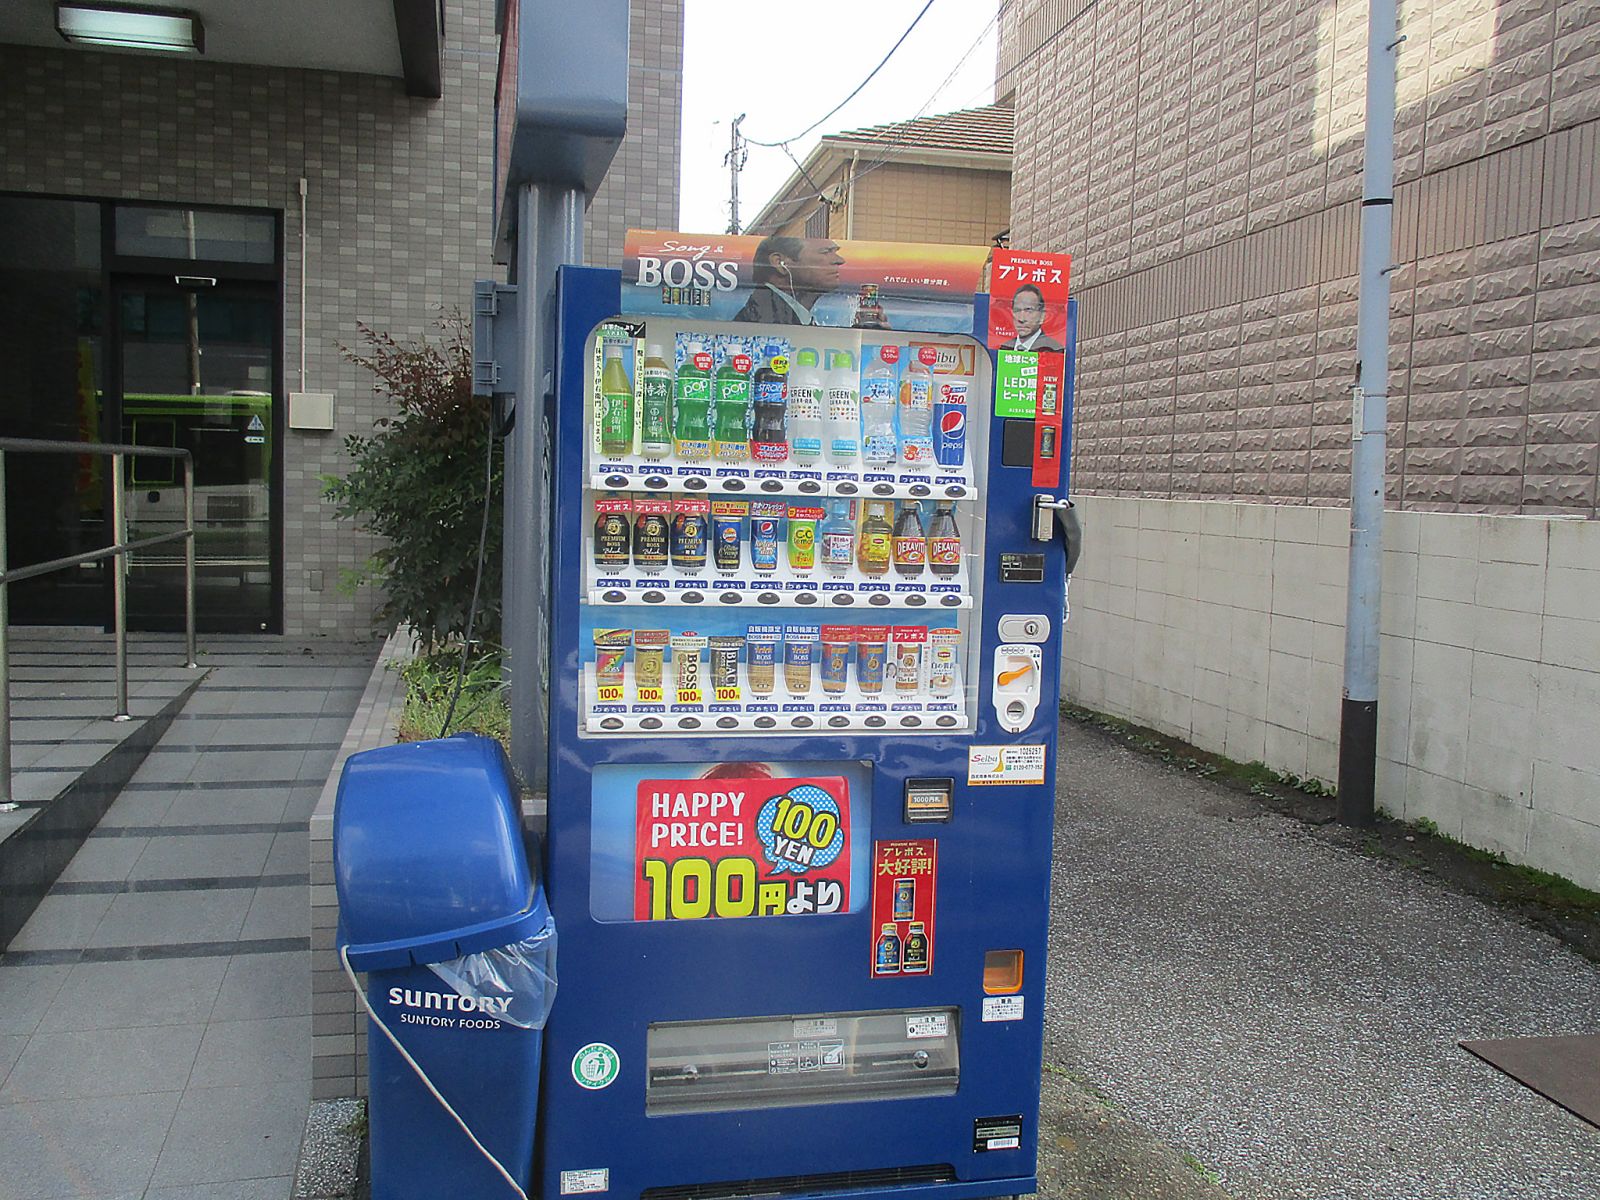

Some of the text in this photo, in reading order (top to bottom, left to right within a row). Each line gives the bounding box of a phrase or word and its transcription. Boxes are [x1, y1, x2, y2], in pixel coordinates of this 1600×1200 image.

[635, 256, 739, 292] BOSS
[998, 264, 1062, 284] プレボス
[941, 442, 964, 450] pepsi
[685, 653, 698, 690] BOSS
[652, 792, 745, 818] HAPPY
[651, 822, 744, 848] PRICE!
[772, 798, 836, 848] 100
[774, 835, 814, 865] YEN
[643, 857, 842, 921] 100円より
[400, 1013, 501, 1030] SUNTORY FOODS
